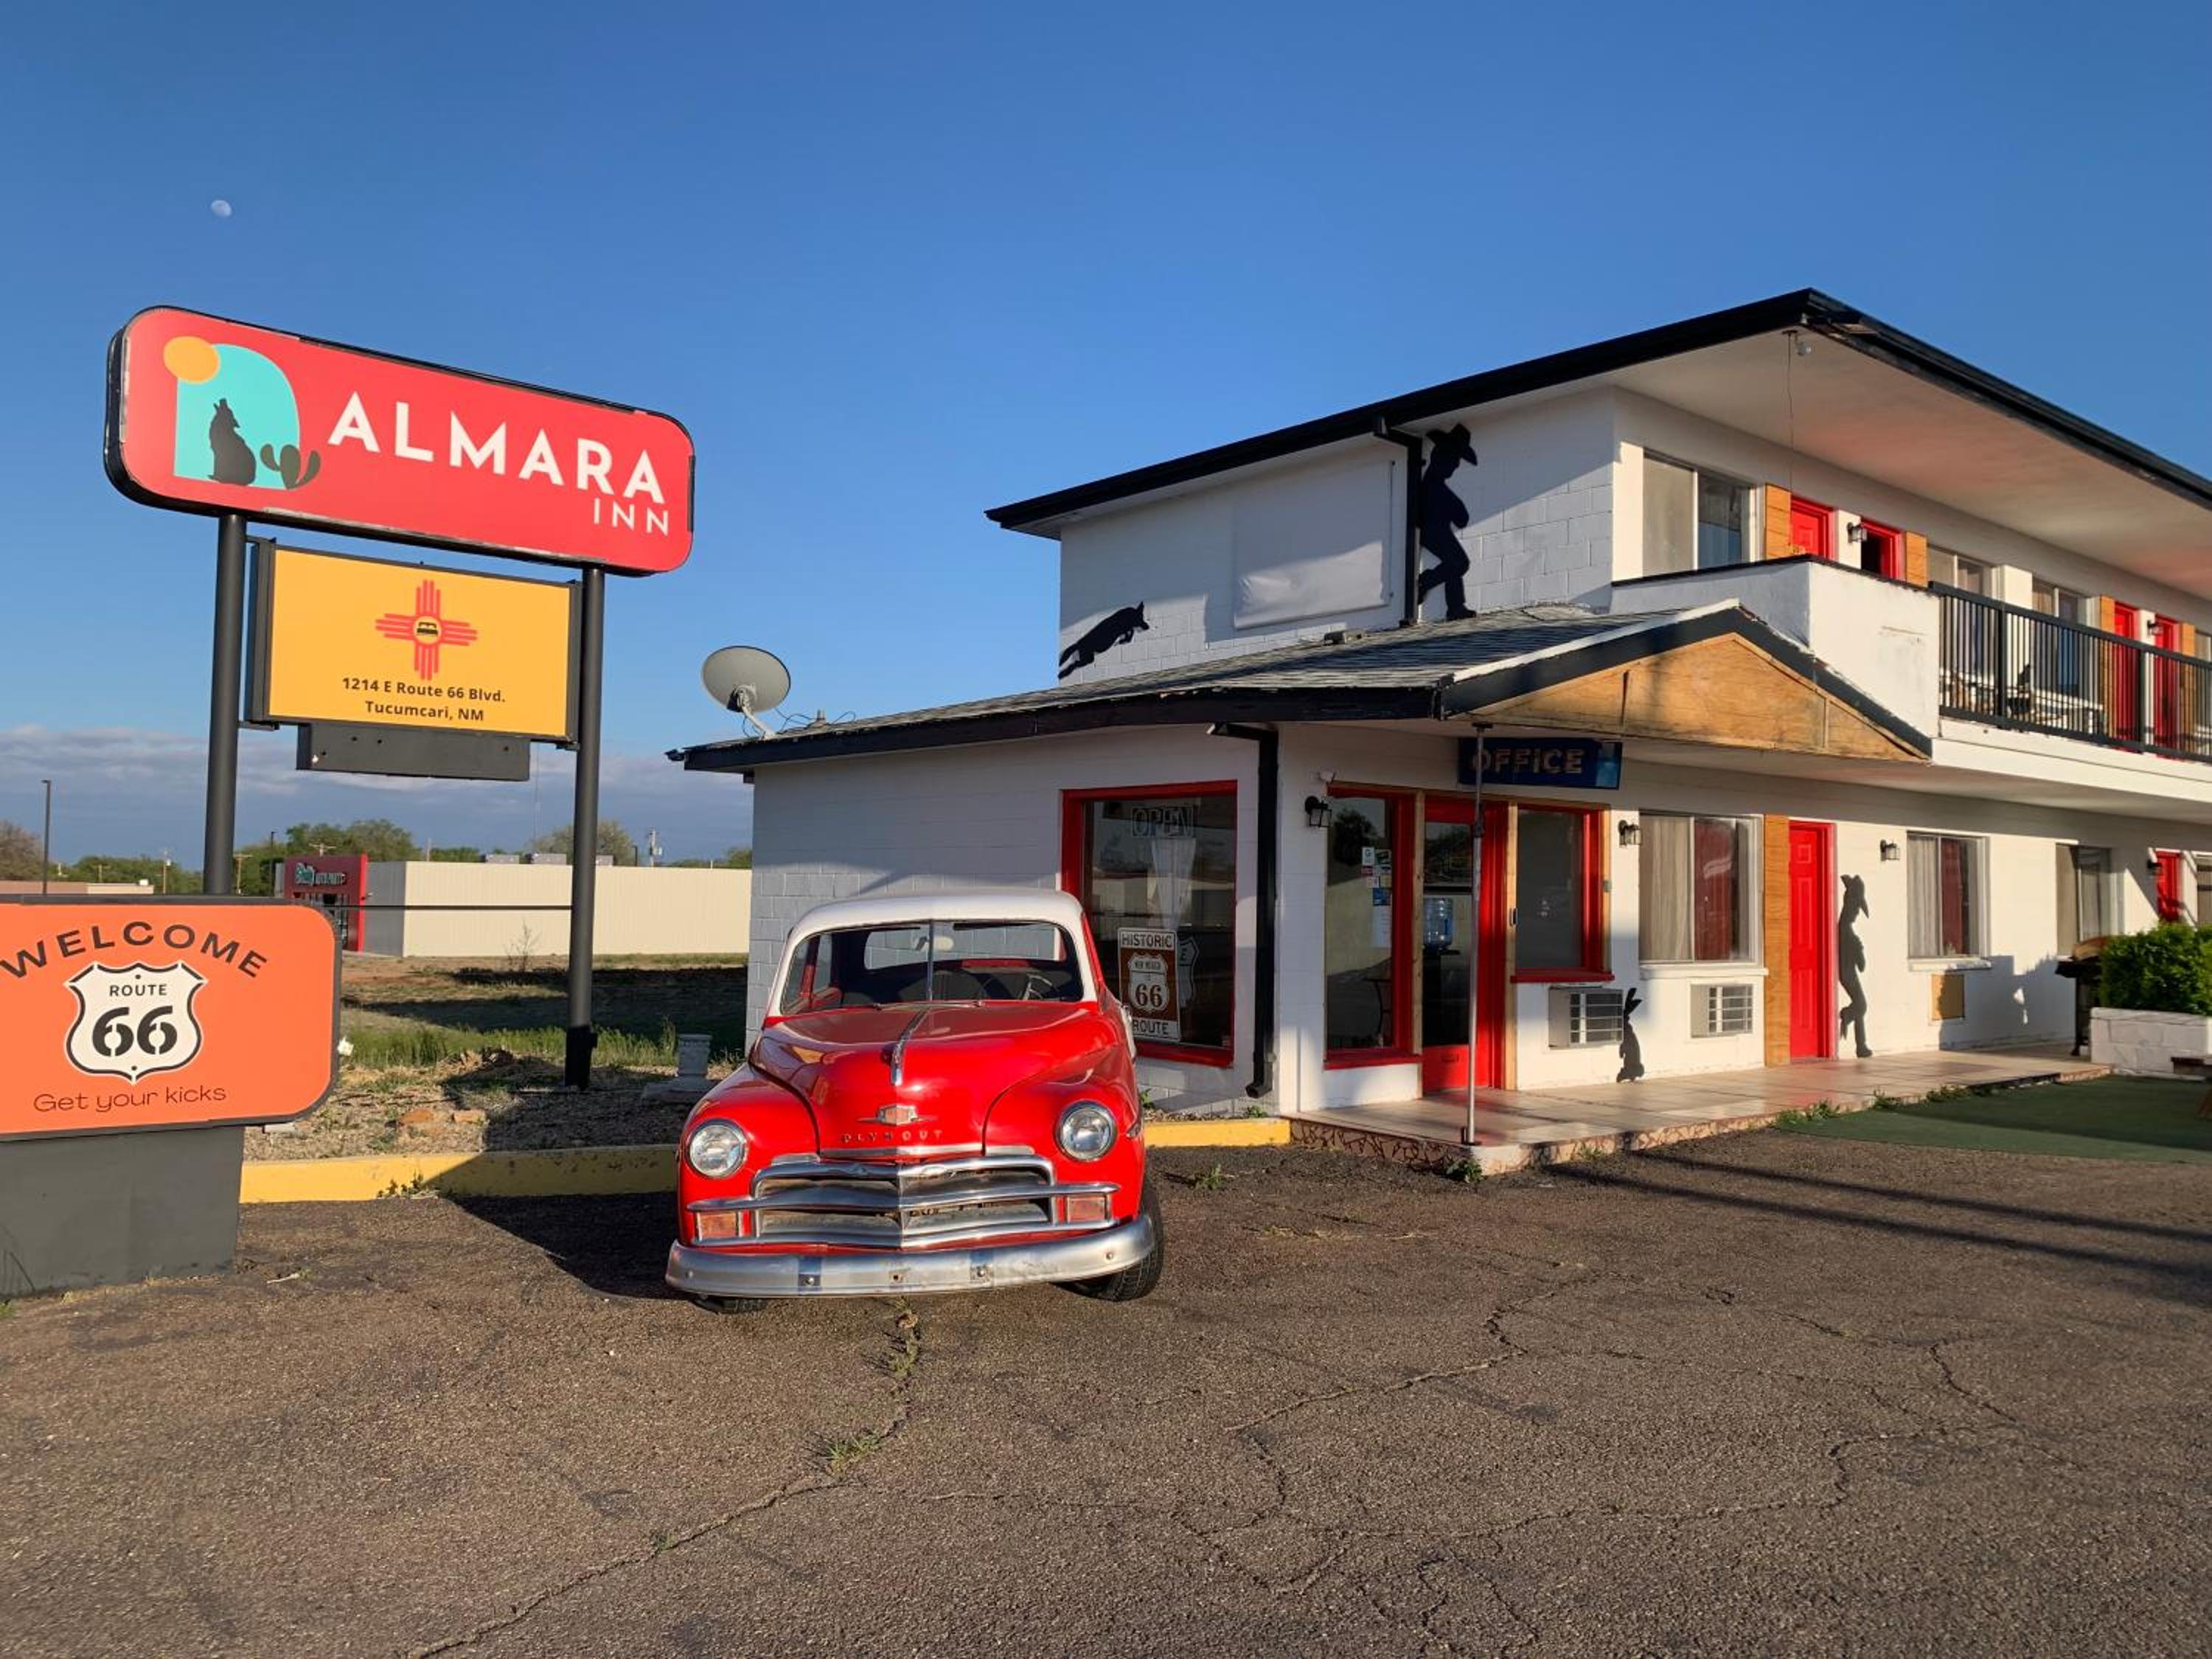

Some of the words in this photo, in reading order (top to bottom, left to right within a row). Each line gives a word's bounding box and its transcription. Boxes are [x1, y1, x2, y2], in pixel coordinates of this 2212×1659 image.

[327, 391, 665, 505] ALMARA
[593, 497, 669, 536] INN
[342, 677, 380, 692] 1214
[383, 681, 392, 692] E
[397, 682, 443, 697] Route
[447, 686, 465, 699] 66
[469, 688, 506, 703] Blvd.
[365, 700, 453, 720] Tucumcari,
[458, 709, 484, 720] NM
[1472, 748, 1585, 773] OFFICE
[1133, 807, 1194, 837] OPEN
[0, 920, 268, 979] WELCOME
[1121, 933, 1173, 948] HISTORIC
[109, 983, 168, 998] ROUTE
[1135, 983, 1163, 1008] 66
[91, 1005, 178, 1057] 66
[1132, 1020, 1169, 1035] ROUTE
[33, 1093, 89, 1113] Get
[96, 1091, 159, 1113] your
[165, 1085, 227, 1105] kicks
